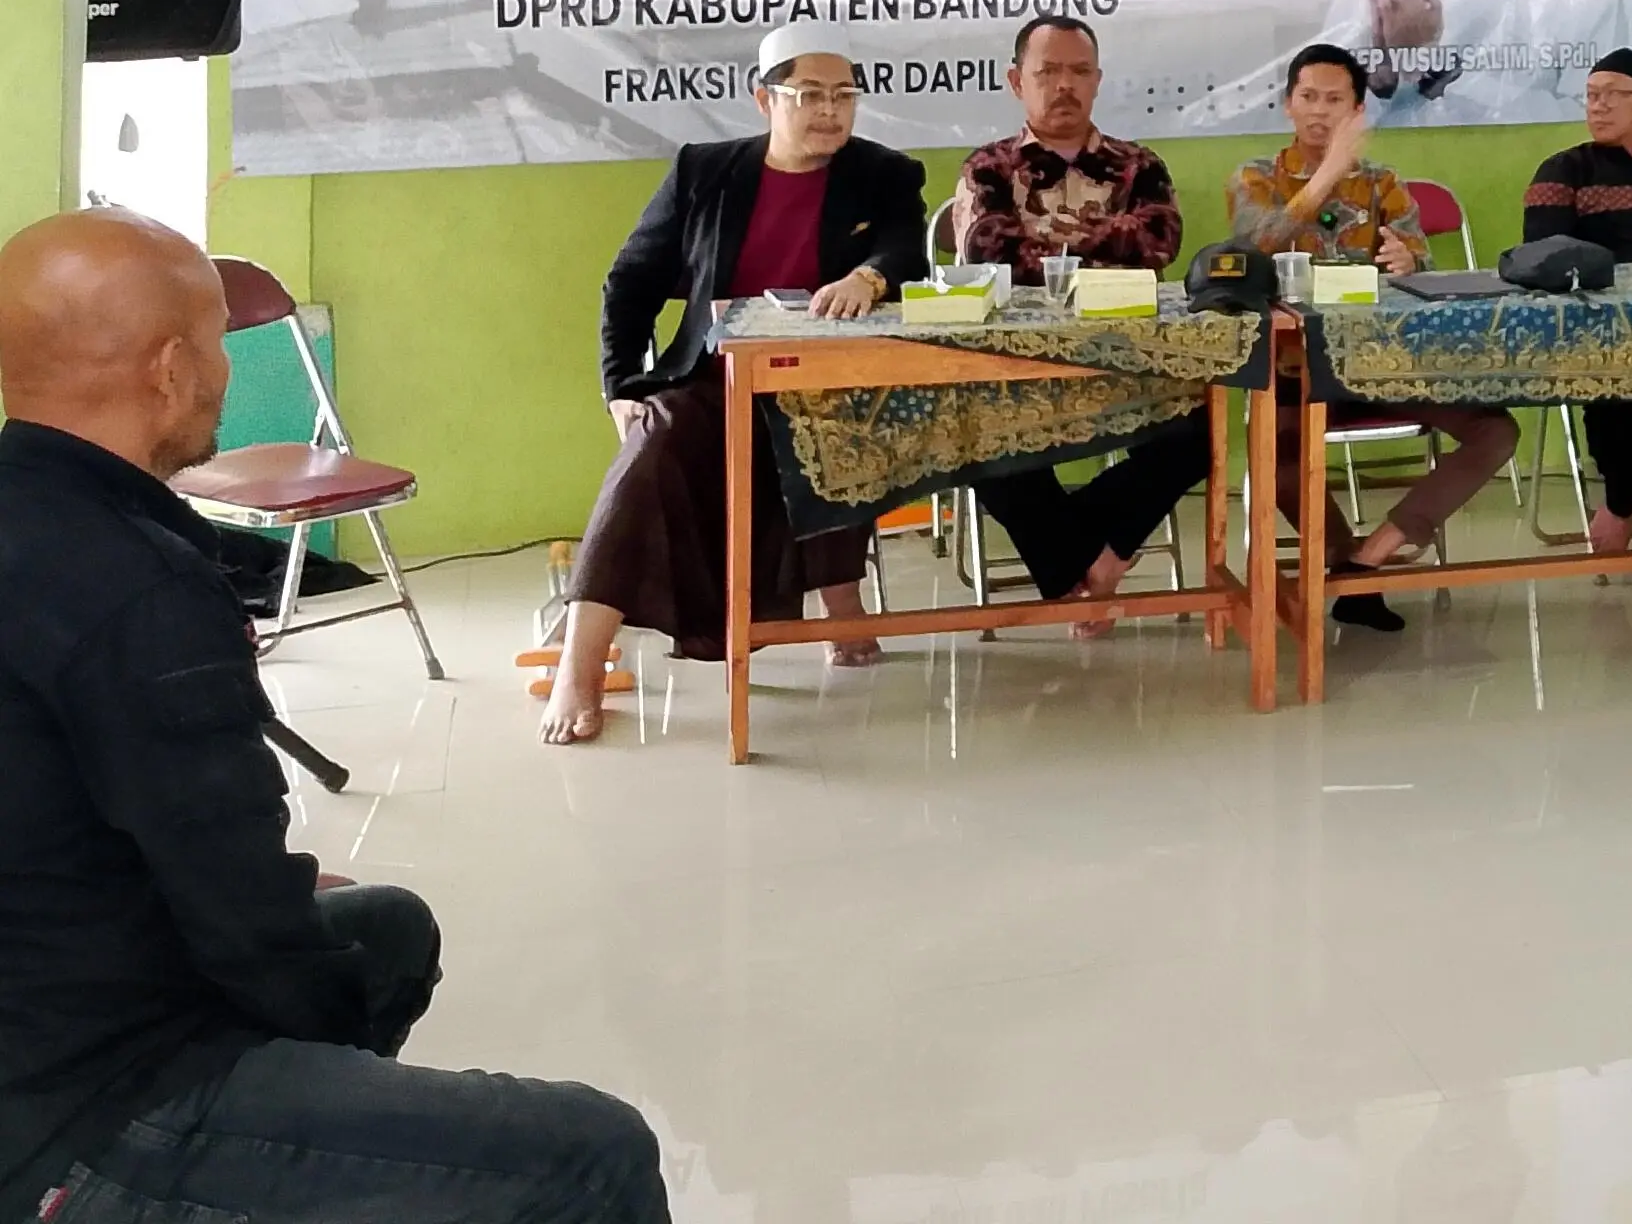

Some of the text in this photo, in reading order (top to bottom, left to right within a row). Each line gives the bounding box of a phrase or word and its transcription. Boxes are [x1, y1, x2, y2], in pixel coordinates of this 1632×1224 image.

[1388, 46, 1458, 73] YUSUF
[1461, 43, 1534, 72] SALIM,
[604, 62, 736, 104] FRAKSI
[904, 58, 1004, 95] DAPIL
